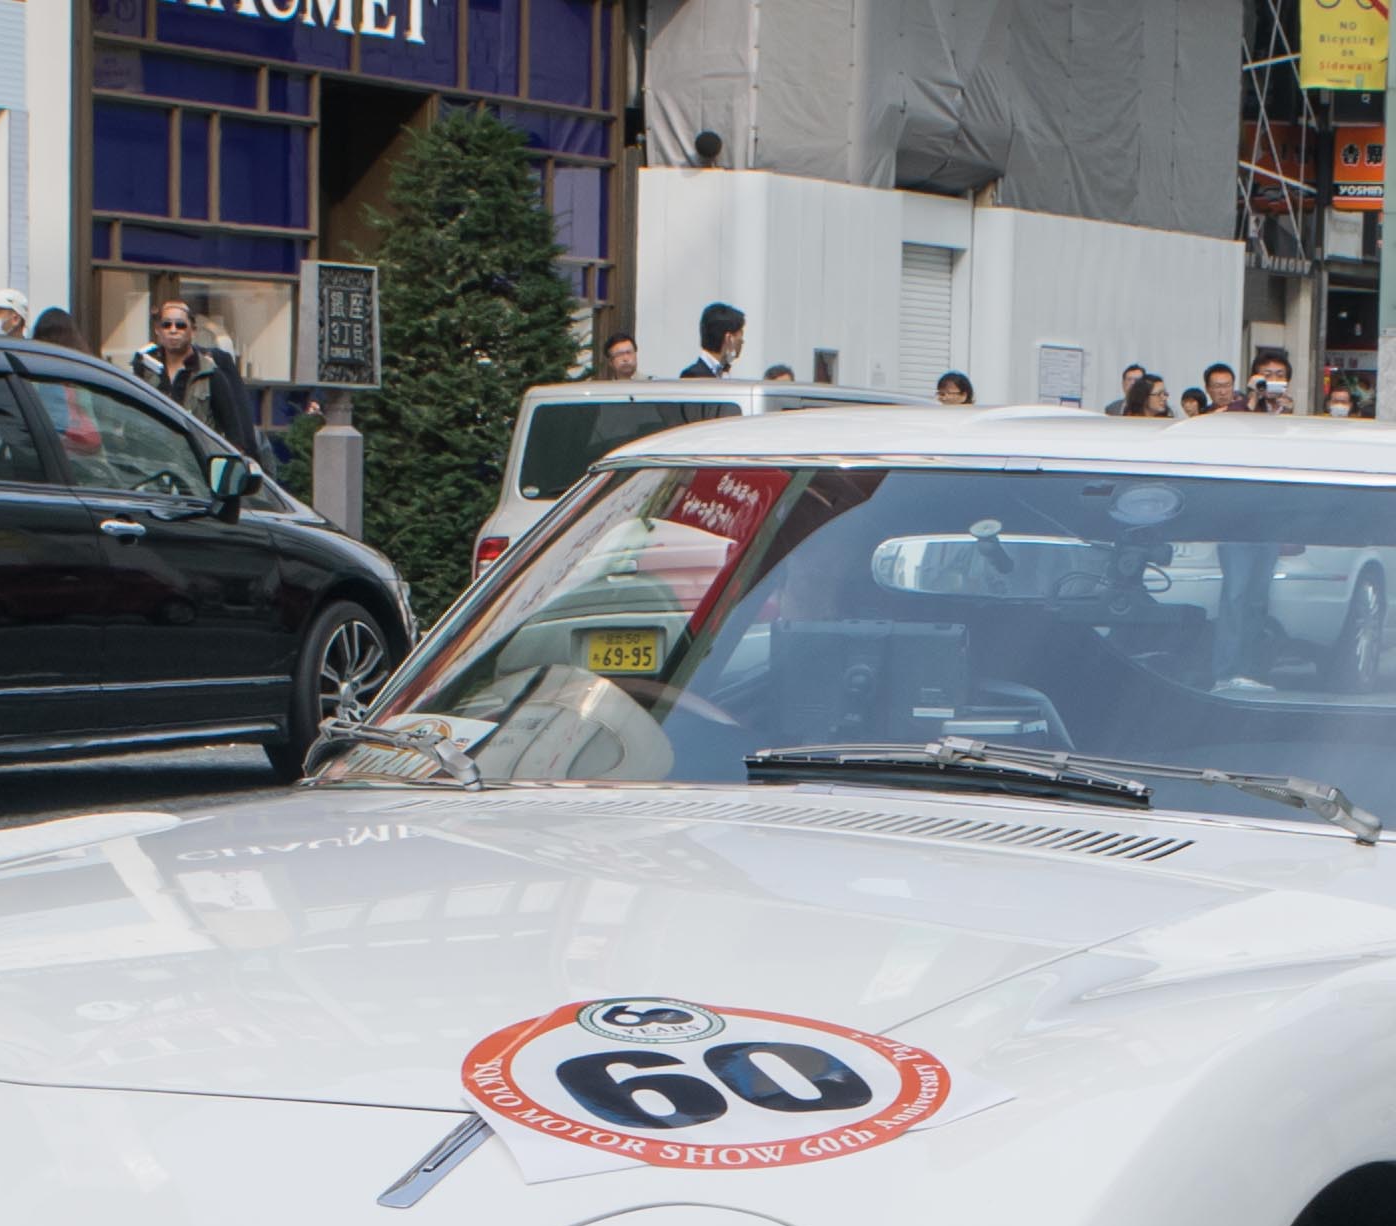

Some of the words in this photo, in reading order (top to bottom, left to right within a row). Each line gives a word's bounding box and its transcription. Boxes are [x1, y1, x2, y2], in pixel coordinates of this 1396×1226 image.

[1319, 34, 1375, 46] Bicycling
[330, 291, 365, 319] 銀座
[602, 646, 652, 667] 69-95
[622, 1023, 702, 1036] YEARS
[555, 1041, 873, 1130] 60
[467, 1057, 523, 1107] TOKYO
[512, 1107, 648, 1154] MOTOR
[659, 1143, 788, 1165] SHOW
[799, 1127, 878, 1157] 60th
[872, 1063, 943, 1131] Anniversary
